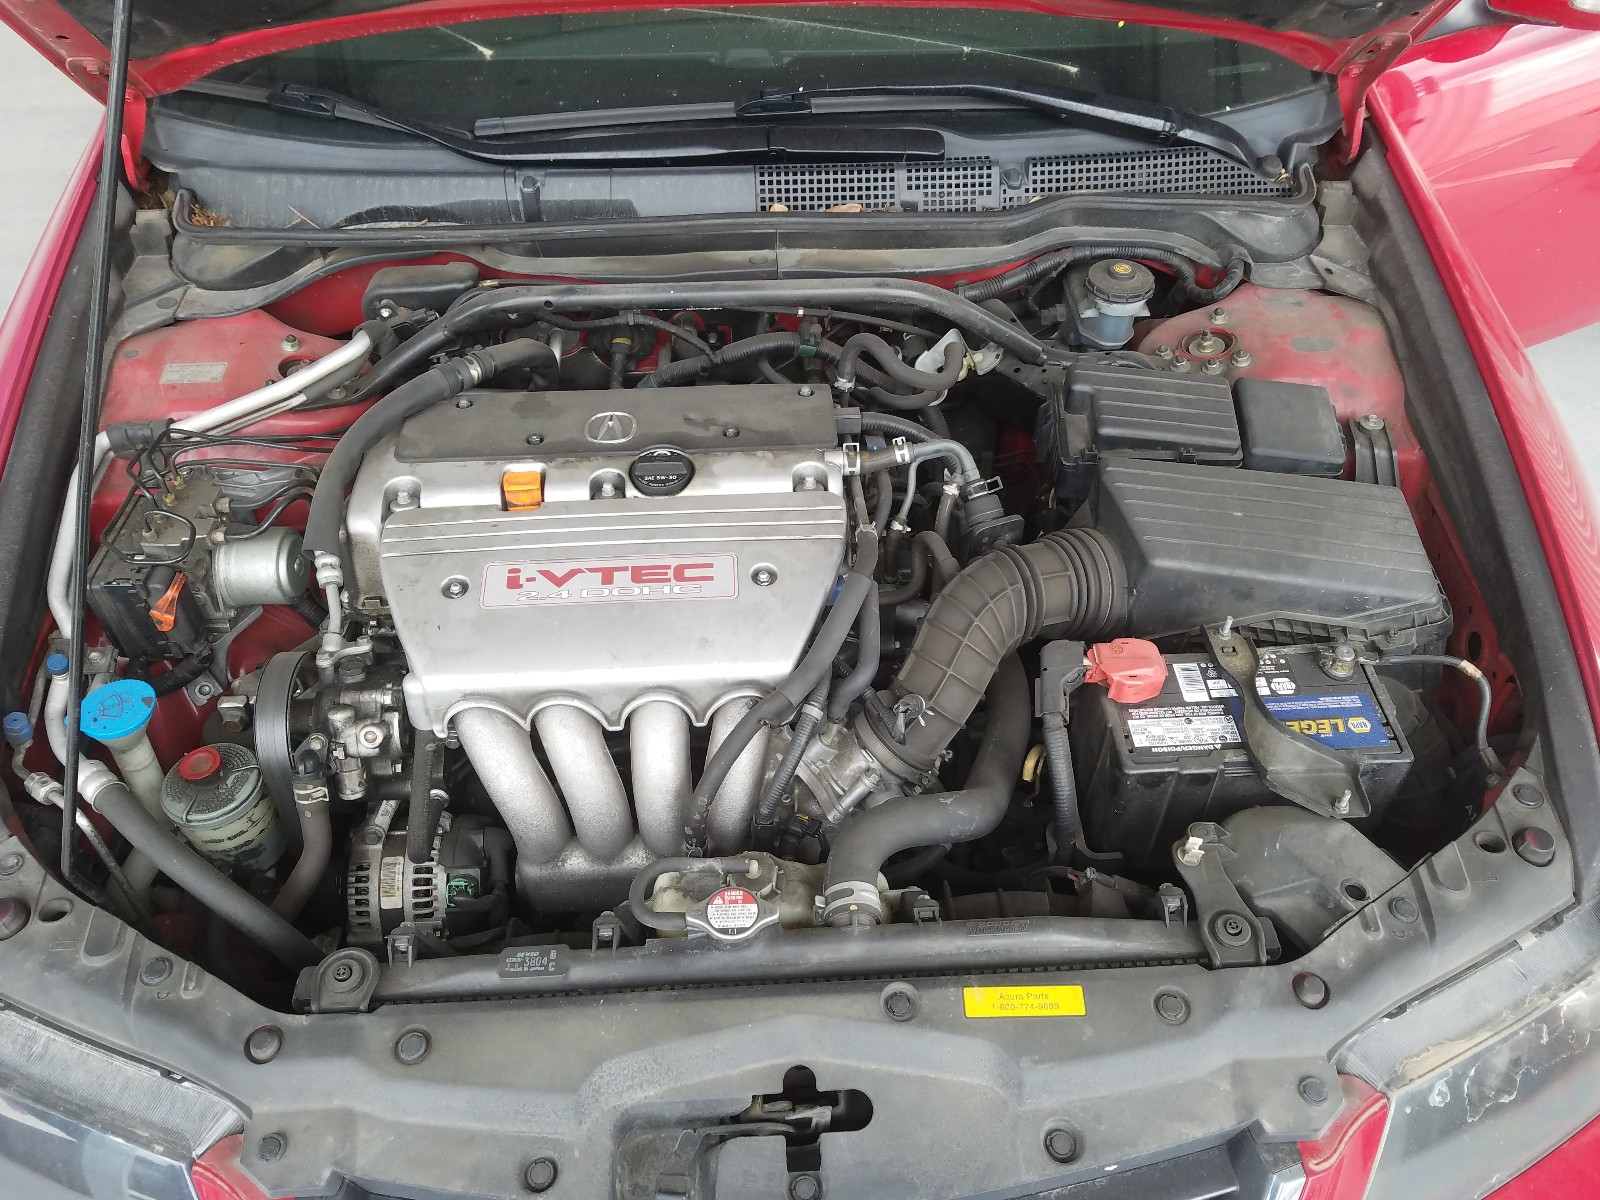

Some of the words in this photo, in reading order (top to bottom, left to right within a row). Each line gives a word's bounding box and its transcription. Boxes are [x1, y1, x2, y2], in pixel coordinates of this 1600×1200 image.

[506, 562, 715, 590] i-VTEC
[516, 589, 571, 601] 2.4
[579, 584, 703, 599] DOHC
[1285, 718, 1347, 735] LEGE
[1152, 744, 1215, 753] DANGER/POISON
[998, 992, 1024, 1000] Acura
[1026, 991, 1049, 1000] Parts
